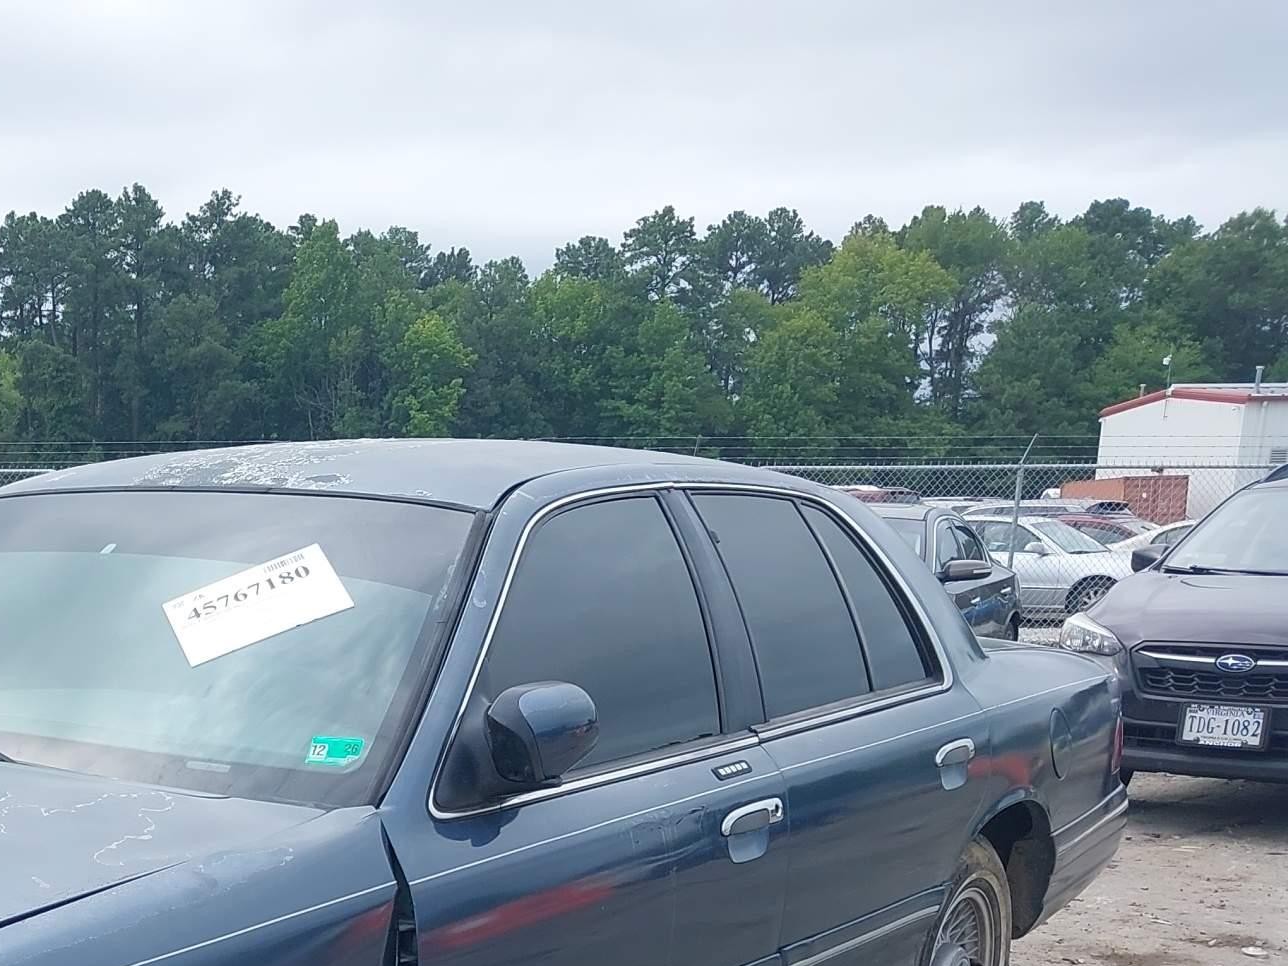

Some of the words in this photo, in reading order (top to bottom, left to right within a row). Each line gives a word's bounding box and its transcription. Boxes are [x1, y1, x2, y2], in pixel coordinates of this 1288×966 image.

[187, 565, 311, 620] 45767180
[1206, 707, 1245, 718] VIRGINIA
[1188, 715, 1261, 737] TDG-1082
[311, 744, 326, 756] 12
